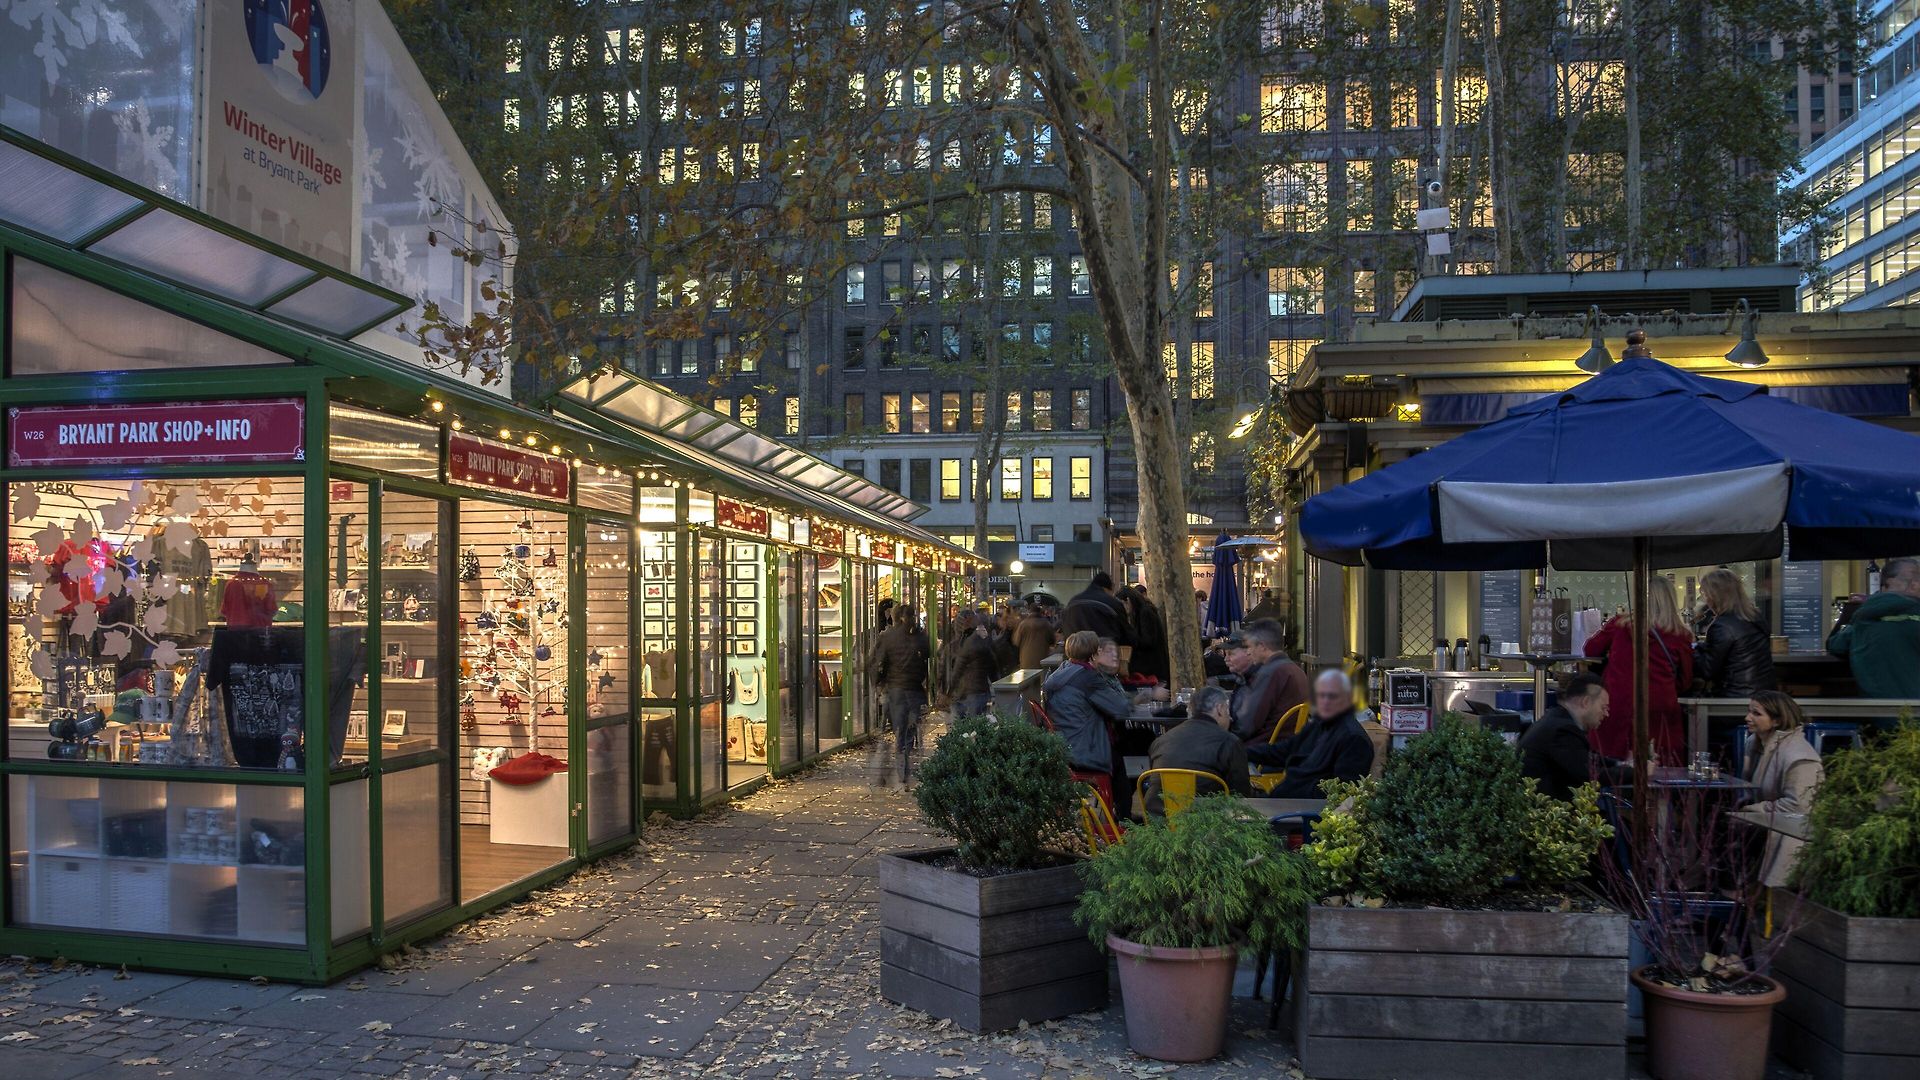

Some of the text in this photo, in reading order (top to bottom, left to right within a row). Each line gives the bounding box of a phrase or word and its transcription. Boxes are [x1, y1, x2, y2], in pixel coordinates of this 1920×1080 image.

[223, 100, 342, 185] Winter Village
[243, 146, 320, 196] at Bryant Park
[23, 430, 45, 441] W26
[59, 423, 115, 445] BRYANT
[119, 422, 159, 444] PARK
[468, 451, 496, 474] BRYANT
[497, 458, 515, 478] PARK
[1397, 689, 1419, 698] nitro
